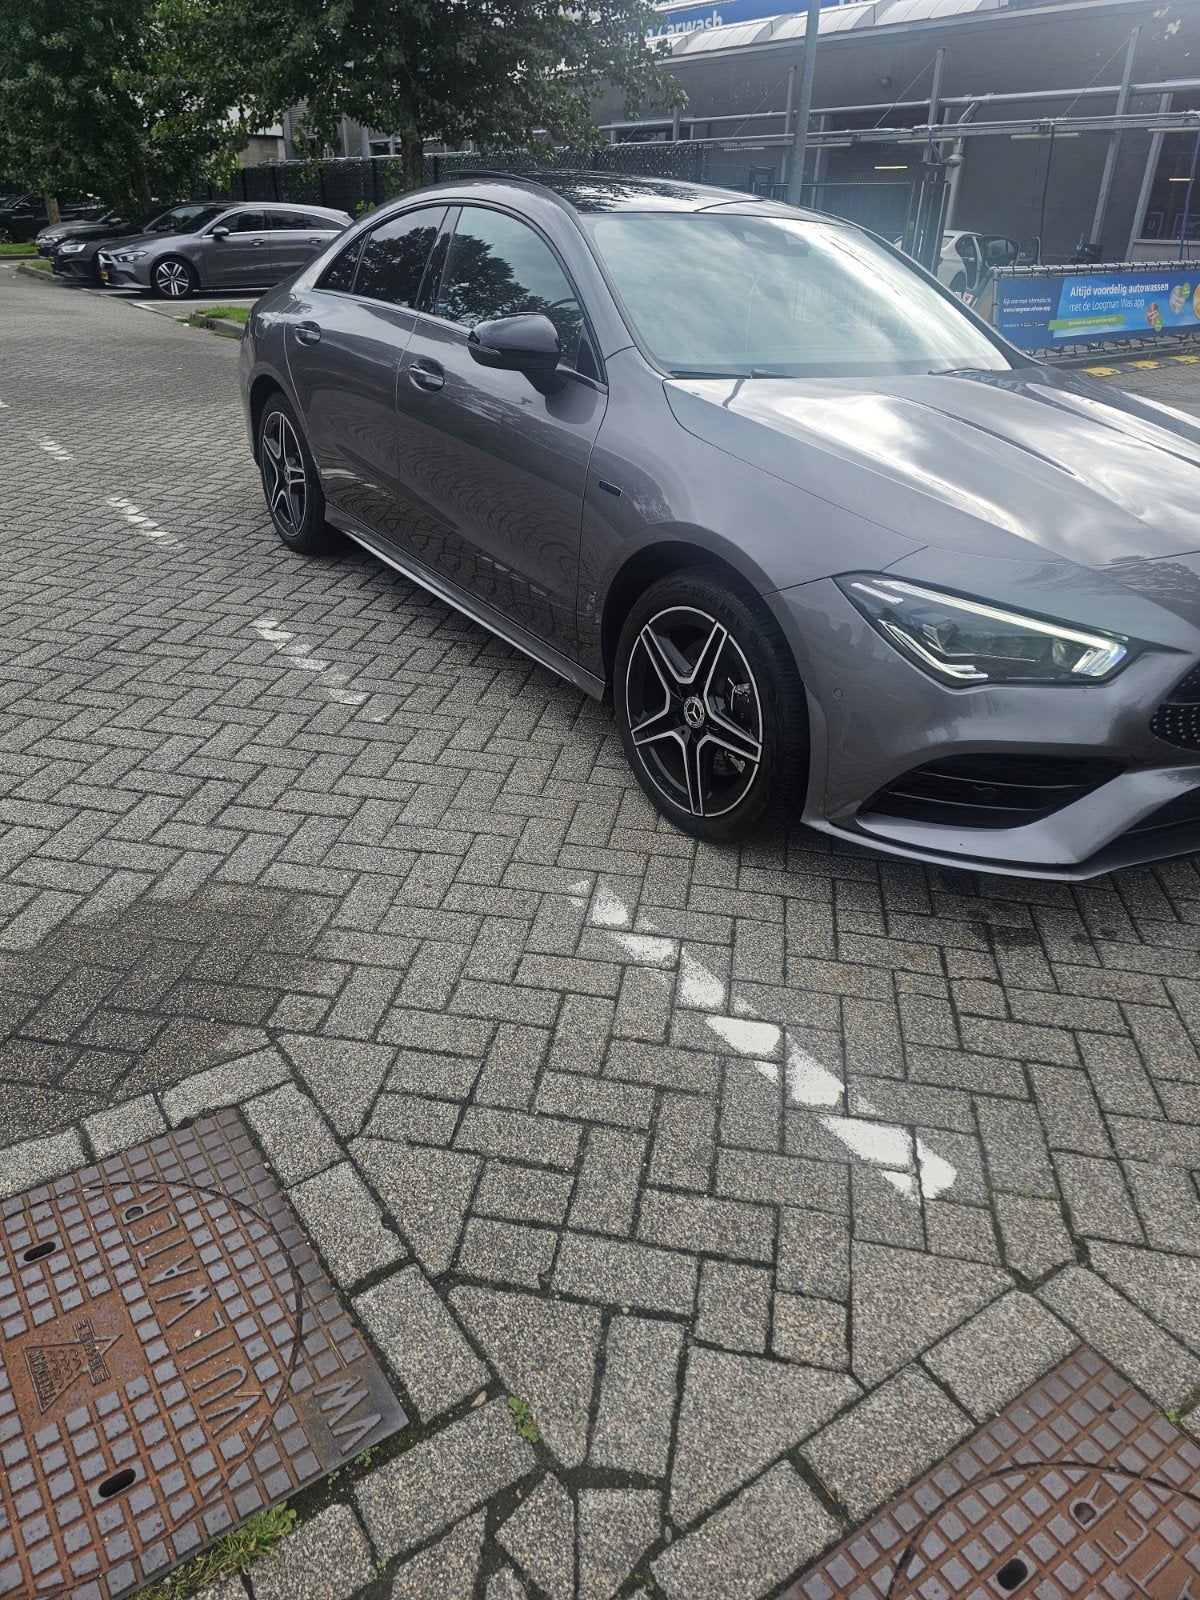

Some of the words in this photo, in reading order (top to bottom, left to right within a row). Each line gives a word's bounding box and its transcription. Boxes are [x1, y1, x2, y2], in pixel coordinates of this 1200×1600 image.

[1070, 286, 1092, 298] Altijd
[1093, 284, 1127, 296] voordelig
[1128, 283, 1169, 293] autowassen
[1069, 302, 1081, 312] met
[1082, 301, 1091, 311] de
[1120, 299, 1133, 308] Was
[1134, 298, 1145, 308] app
